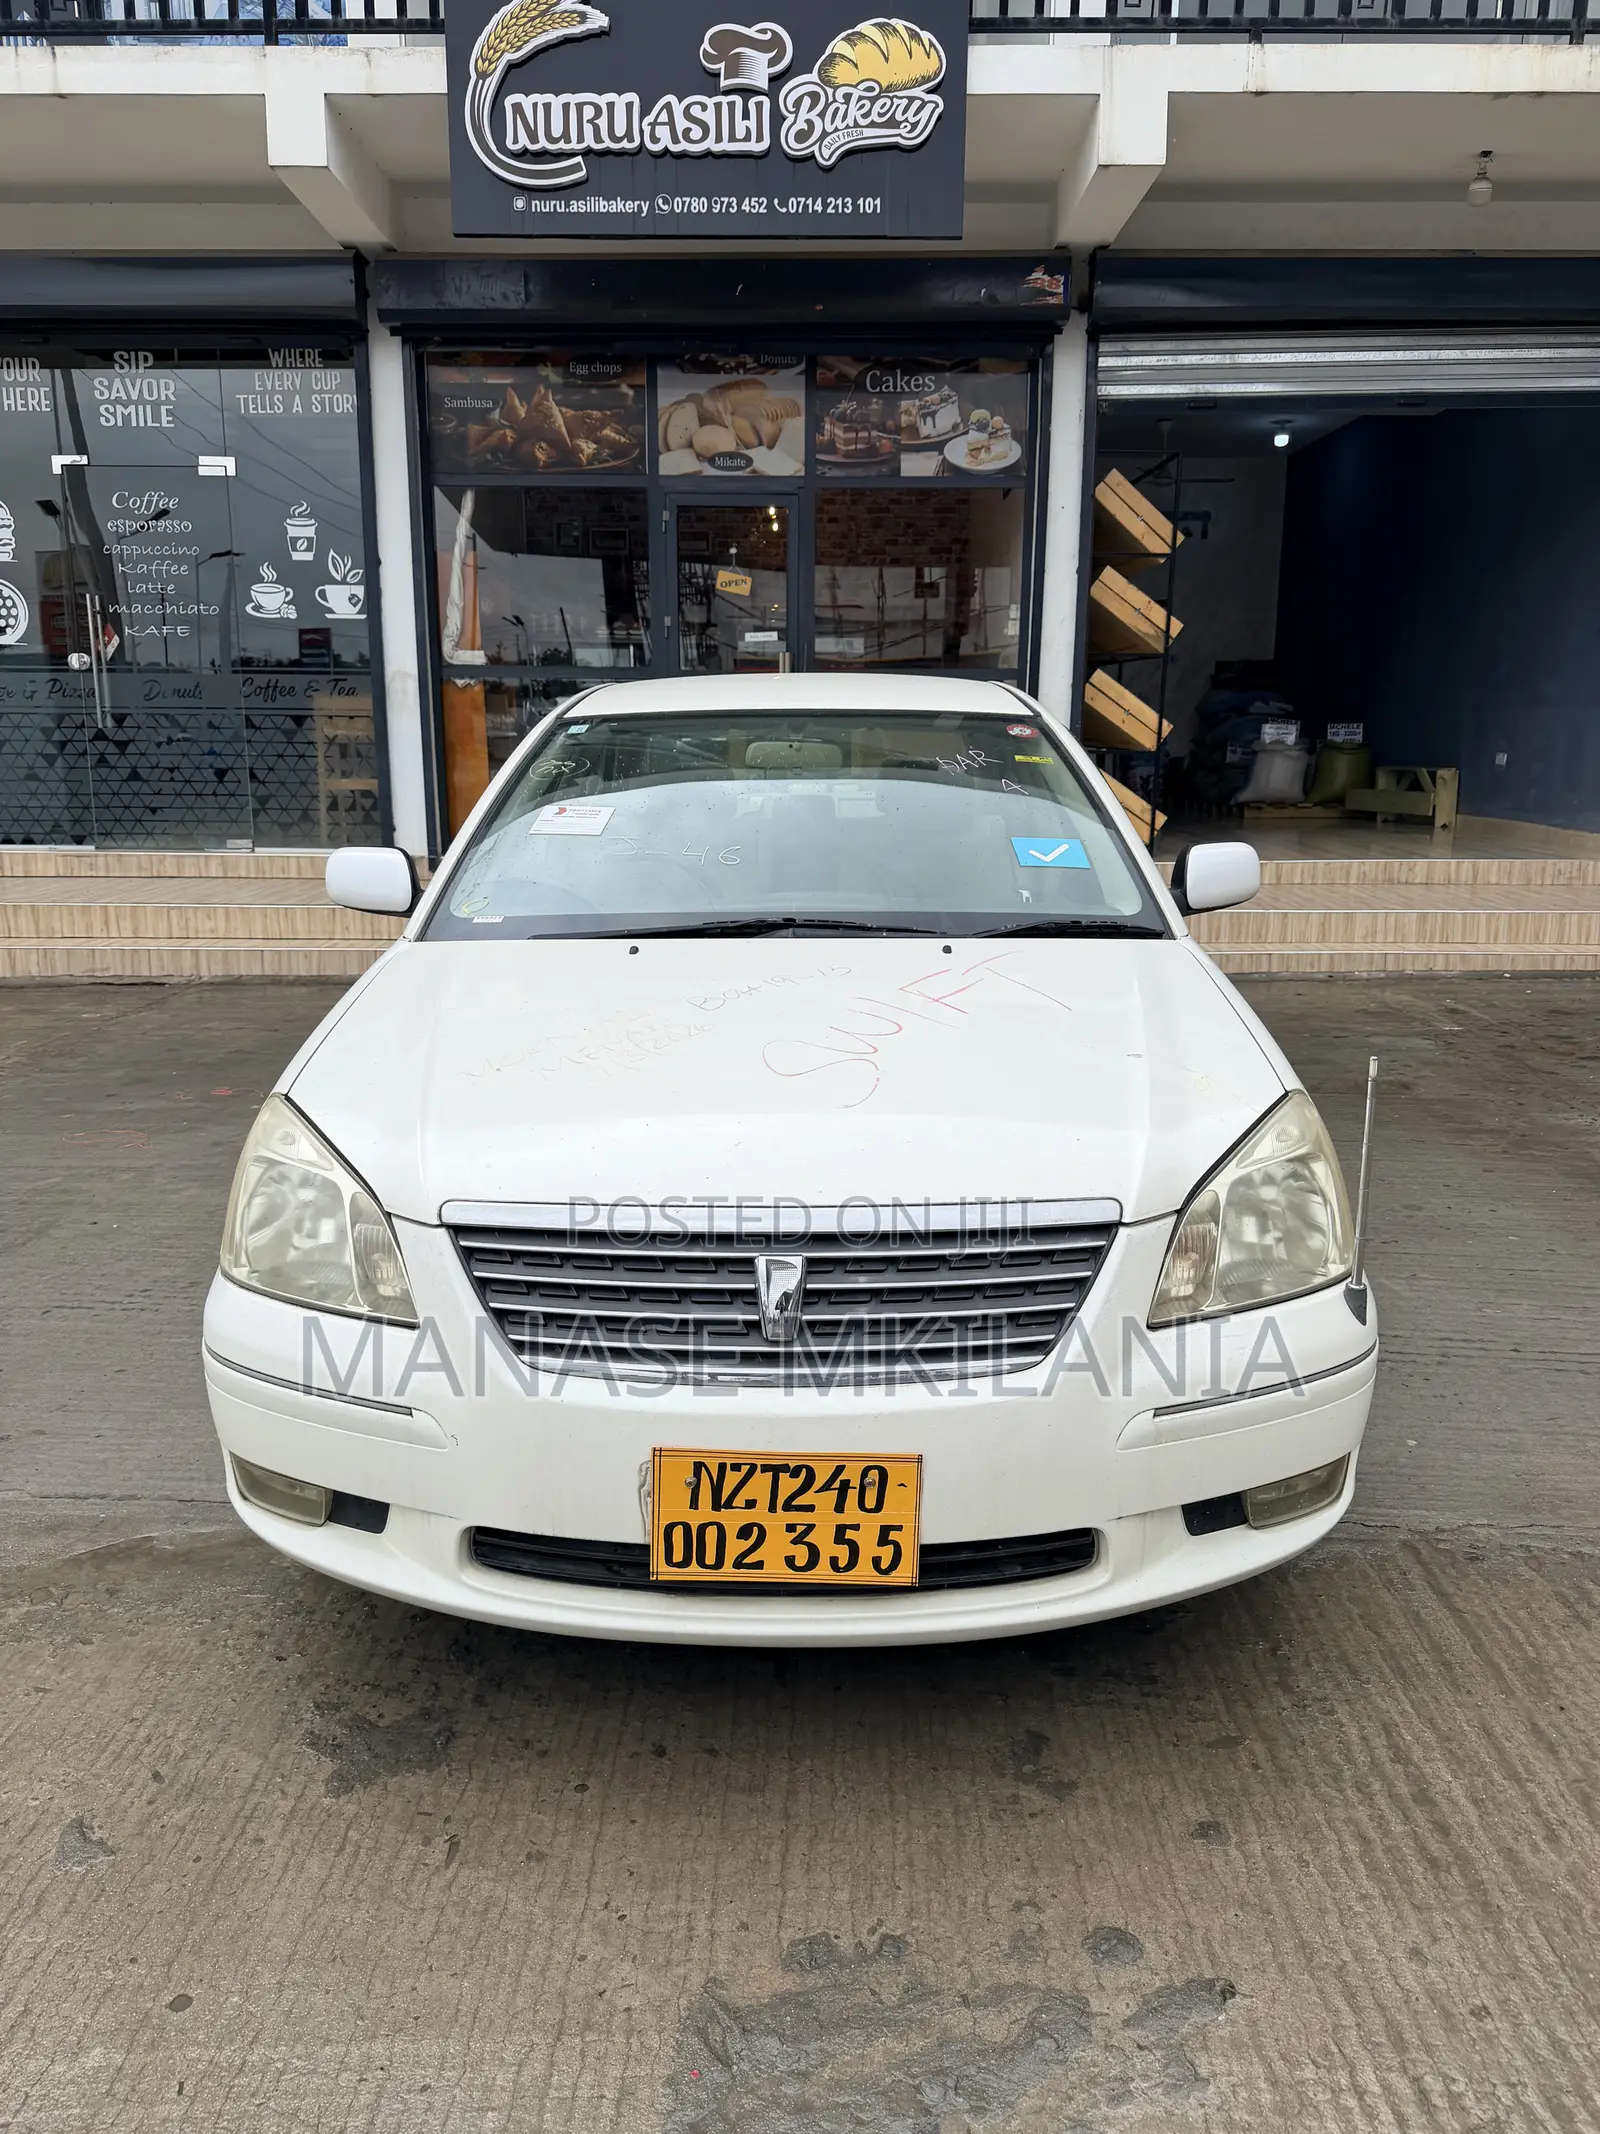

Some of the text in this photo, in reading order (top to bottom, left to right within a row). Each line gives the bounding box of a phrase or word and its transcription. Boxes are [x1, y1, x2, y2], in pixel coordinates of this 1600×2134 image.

[508, 97, 766, 148] NURU ASILI
[785, 80, 940, 146] Bakery
[823, 127, 865, 151] DAILY FRESH
[531, 196, 882, 217] nuru.asilibakery 0780 973 452 0714 213 101
[113, 351, 154, 374] SIP
[269, 348, 323, 368] WHERE
[569, 361, 622, 375] Egg chops
[760, 354, 797, 365] Donuts
[0, 356, 41, 383] OUR
[93, 378, 177, 401] SAVOR
[254, 371, 341, 391] EVERY CUP
[865, 369, 936, 393] Cakes
[2, 386, 51, 412] HERE
[236, 394, 284, 414] TELLS
[292, 394, 304, 413] A
[444, 396, 494, 409] Sambusa
[99, 403, 176, 428] SMILE
[714, 456, 747, 467] Mikate
[111, 490, 180, 514] Coffee
[107, 518, 193, 536] esporasso
[103, 542, 200, 559] cappuccino
[117, 561, 190, 577] Kaffee
[127, 581, 177, 595] latte
[718, 576, 749, 589] OPEN
[108, 600, 220, 616] macchiato
[124, 624, 192, 638] KAFE
[45, 677, 97, 700] Pizza
[241, 676, 298, 704] Coffee
[326, 677, 361, 698] Tea
